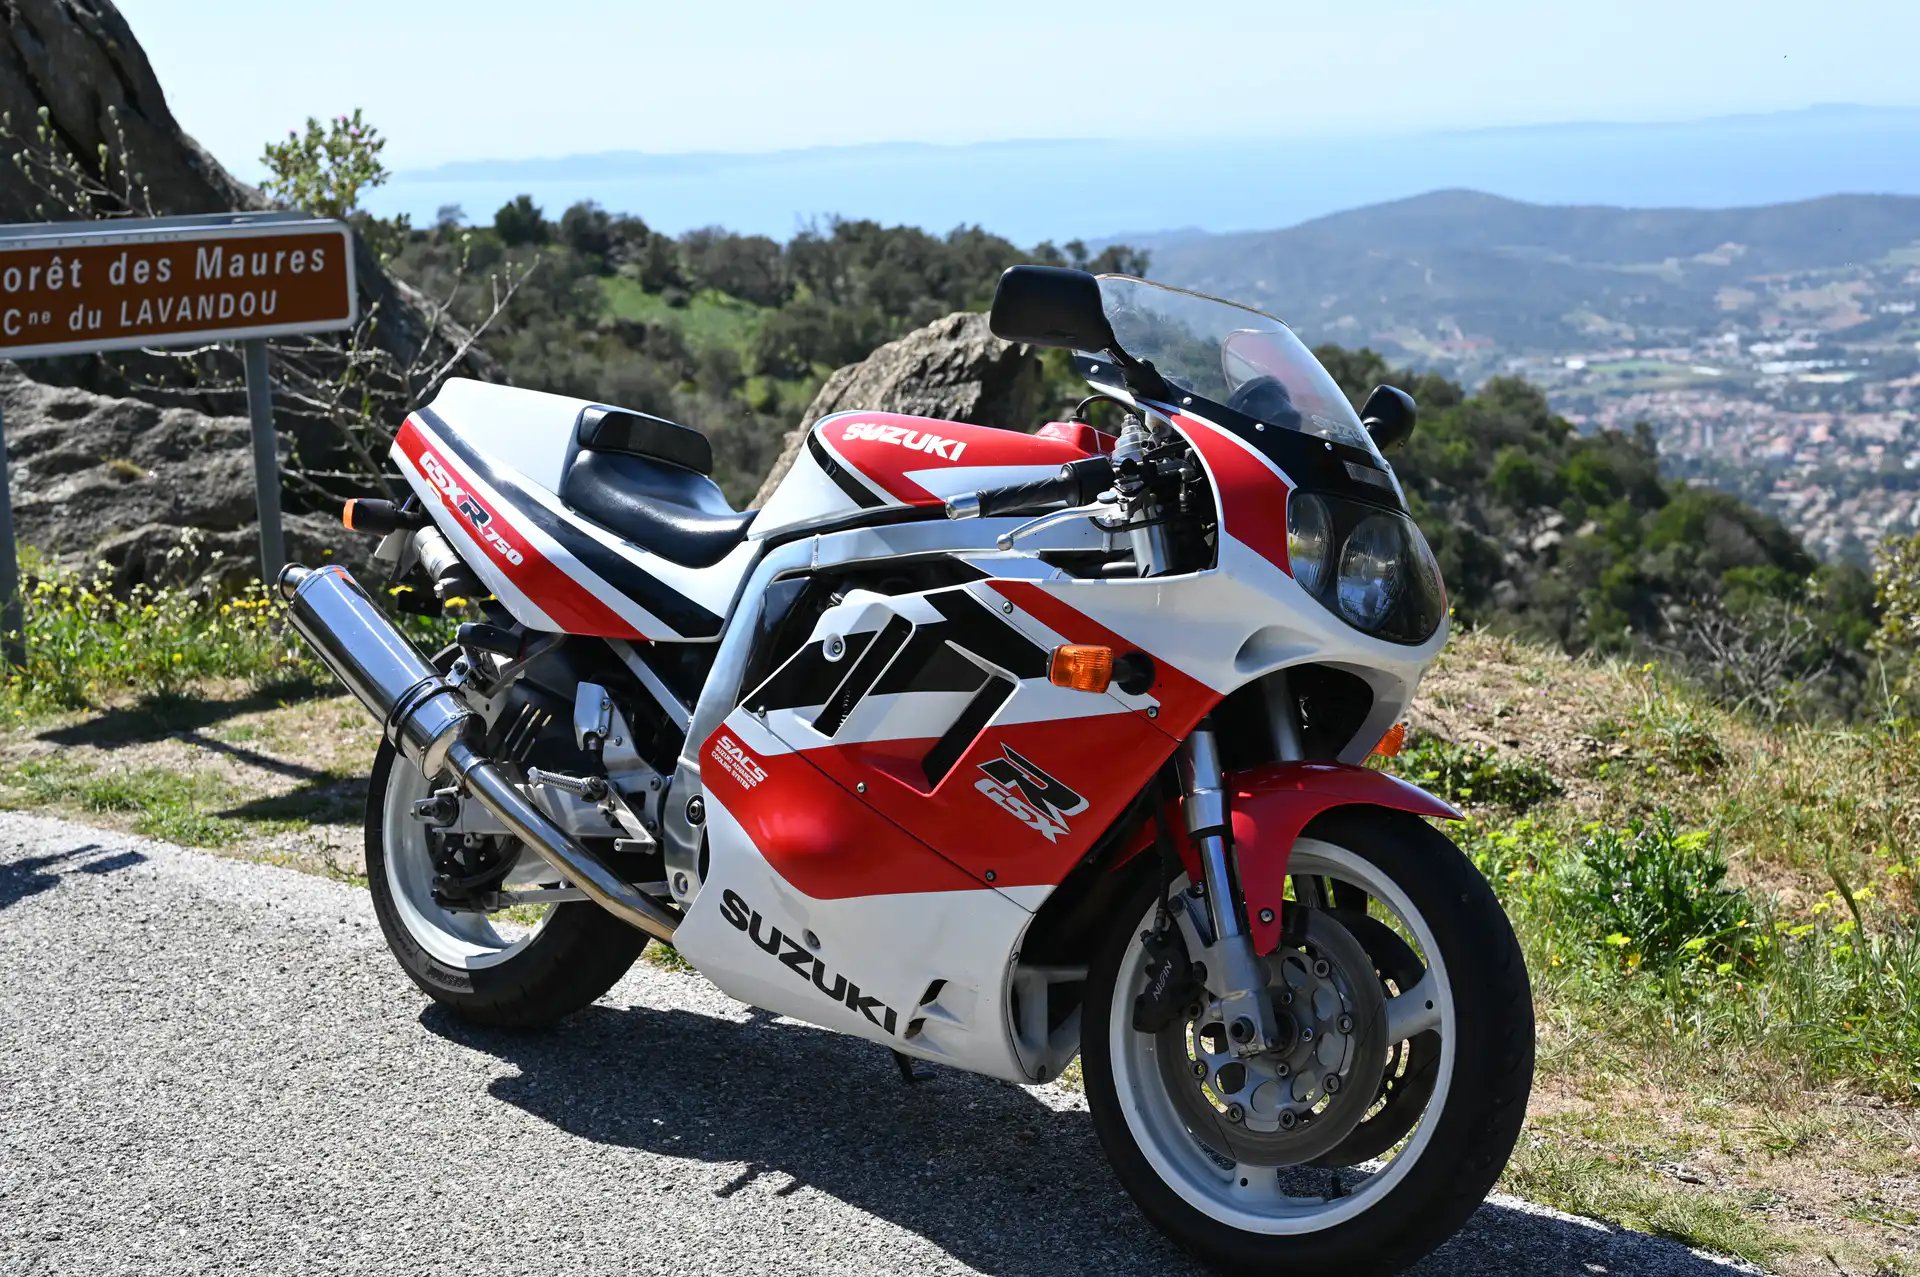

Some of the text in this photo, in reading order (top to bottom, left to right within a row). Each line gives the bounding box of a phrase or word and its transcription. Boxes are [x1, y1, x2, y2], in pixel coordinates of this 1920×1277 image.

[109, 252, 172, 285] des
[195, 247, 325, 280] Maures
[69, 303, 102, 331] du
[120, 290, 278, 327] LAVANDOU
[842, 423, 967, 462] SUZUKI
[484, 527, 524, 566] 750
[711, 751, 750, 790] COOLING SYSTEM
[715, 745, 757, 787] SUZUKI ADVANCED
[717, 735, 769, 782] SACS
[976, 741, 1090, 832] R
[974, 778, 1071, 844] GSX
[720, 889, 898, 1036] SUZUKI
